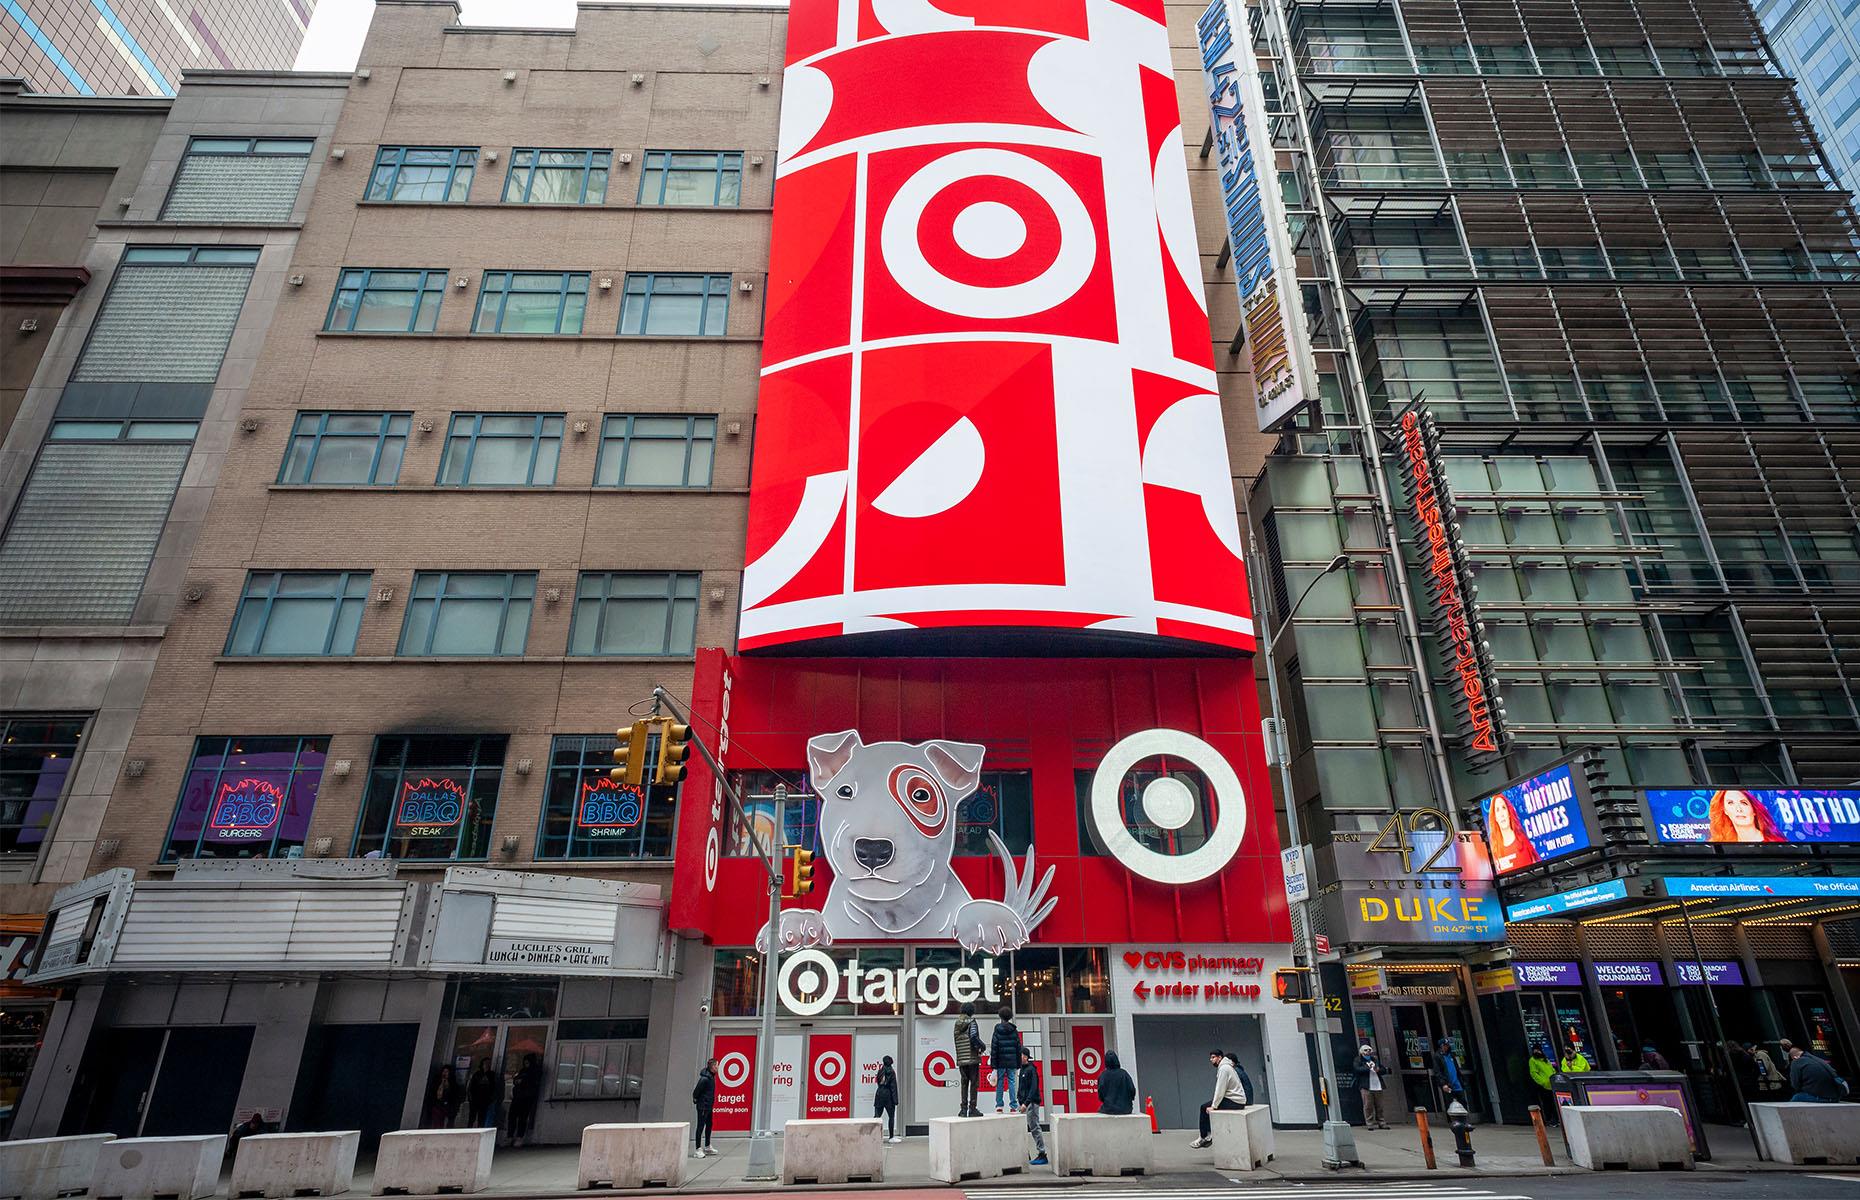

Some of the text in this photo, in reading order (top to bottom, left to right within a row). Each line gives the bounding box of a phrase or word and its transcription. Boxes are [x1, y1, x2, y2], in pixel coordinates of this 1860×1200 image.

[1222, 148, 1274, 299] STUDIOS
[1243, 277, 1277, 311] THE
[1245, 289, 1292, 395] DUKE
[1401, 411, 1496, 752] American Airlines Theatre
[712, 668, 732, 822] target
[226, 794, 274, 803] DALLAS
[410, 792, 457, 801] DALLAS
[589, 793, 635, 802] DALLAS
[1524, 776, 1572, 814] BIRTHDAY
[215, 803, 276, 825] BBQ
[400, 801, 459, 823] BBQ
[582, 801, 639, 824] BBQ
[1524, 805, 1569, 839] CANDLES
[219, 829, 262, 837] BURGERS
[411, 827, 441, 836] STEAK
[591, 828, 626, 837] SHRIMP
[1334, 807, 1472, 873] NEW 42 ST
[1285, 850, 1299, 863] NYPD
[1369, 880, 1467, 889] STUDIOS
[1691, 883, 1760, 892] American Airlines
[1813, 883, 1859, 891] The Official
[1359, 897, 1487, 922] DUKE
[1433, 925, 1449, 933] ON
[1476, 925, 1489, 933] ST
[511, 943, 593, 954] LUCILLE'S GRILL
[490, 951, 609, 966] LUNCH DINNER LATE NITE
[1143, 951, 1264, 973] CVS pharmacy
[1595, 965, 1641, 974] WELCOME
[1598, 973, 1652, 982] ROUNDABOUT
[843, 958, 1000, 1016] target
[1154, 981, 1261, 1000] order pickup
[1386, 986, 1401, 996] 2ND
[1402, 986, 1426, 996] STREET
[1427, 985, 1455, 996] STUDIOS
[1323, 997, 1342, 1011] 42
[862, 1061, 883, 1071] we'r
[773, 1074, 793, 1087] ring
[1080, 1078, 1098, 1087] targe
[717, 1093, 745, 1104] target
[815, 1092, 842, 1103] target
[712, 1106, 733, 1114] coming
